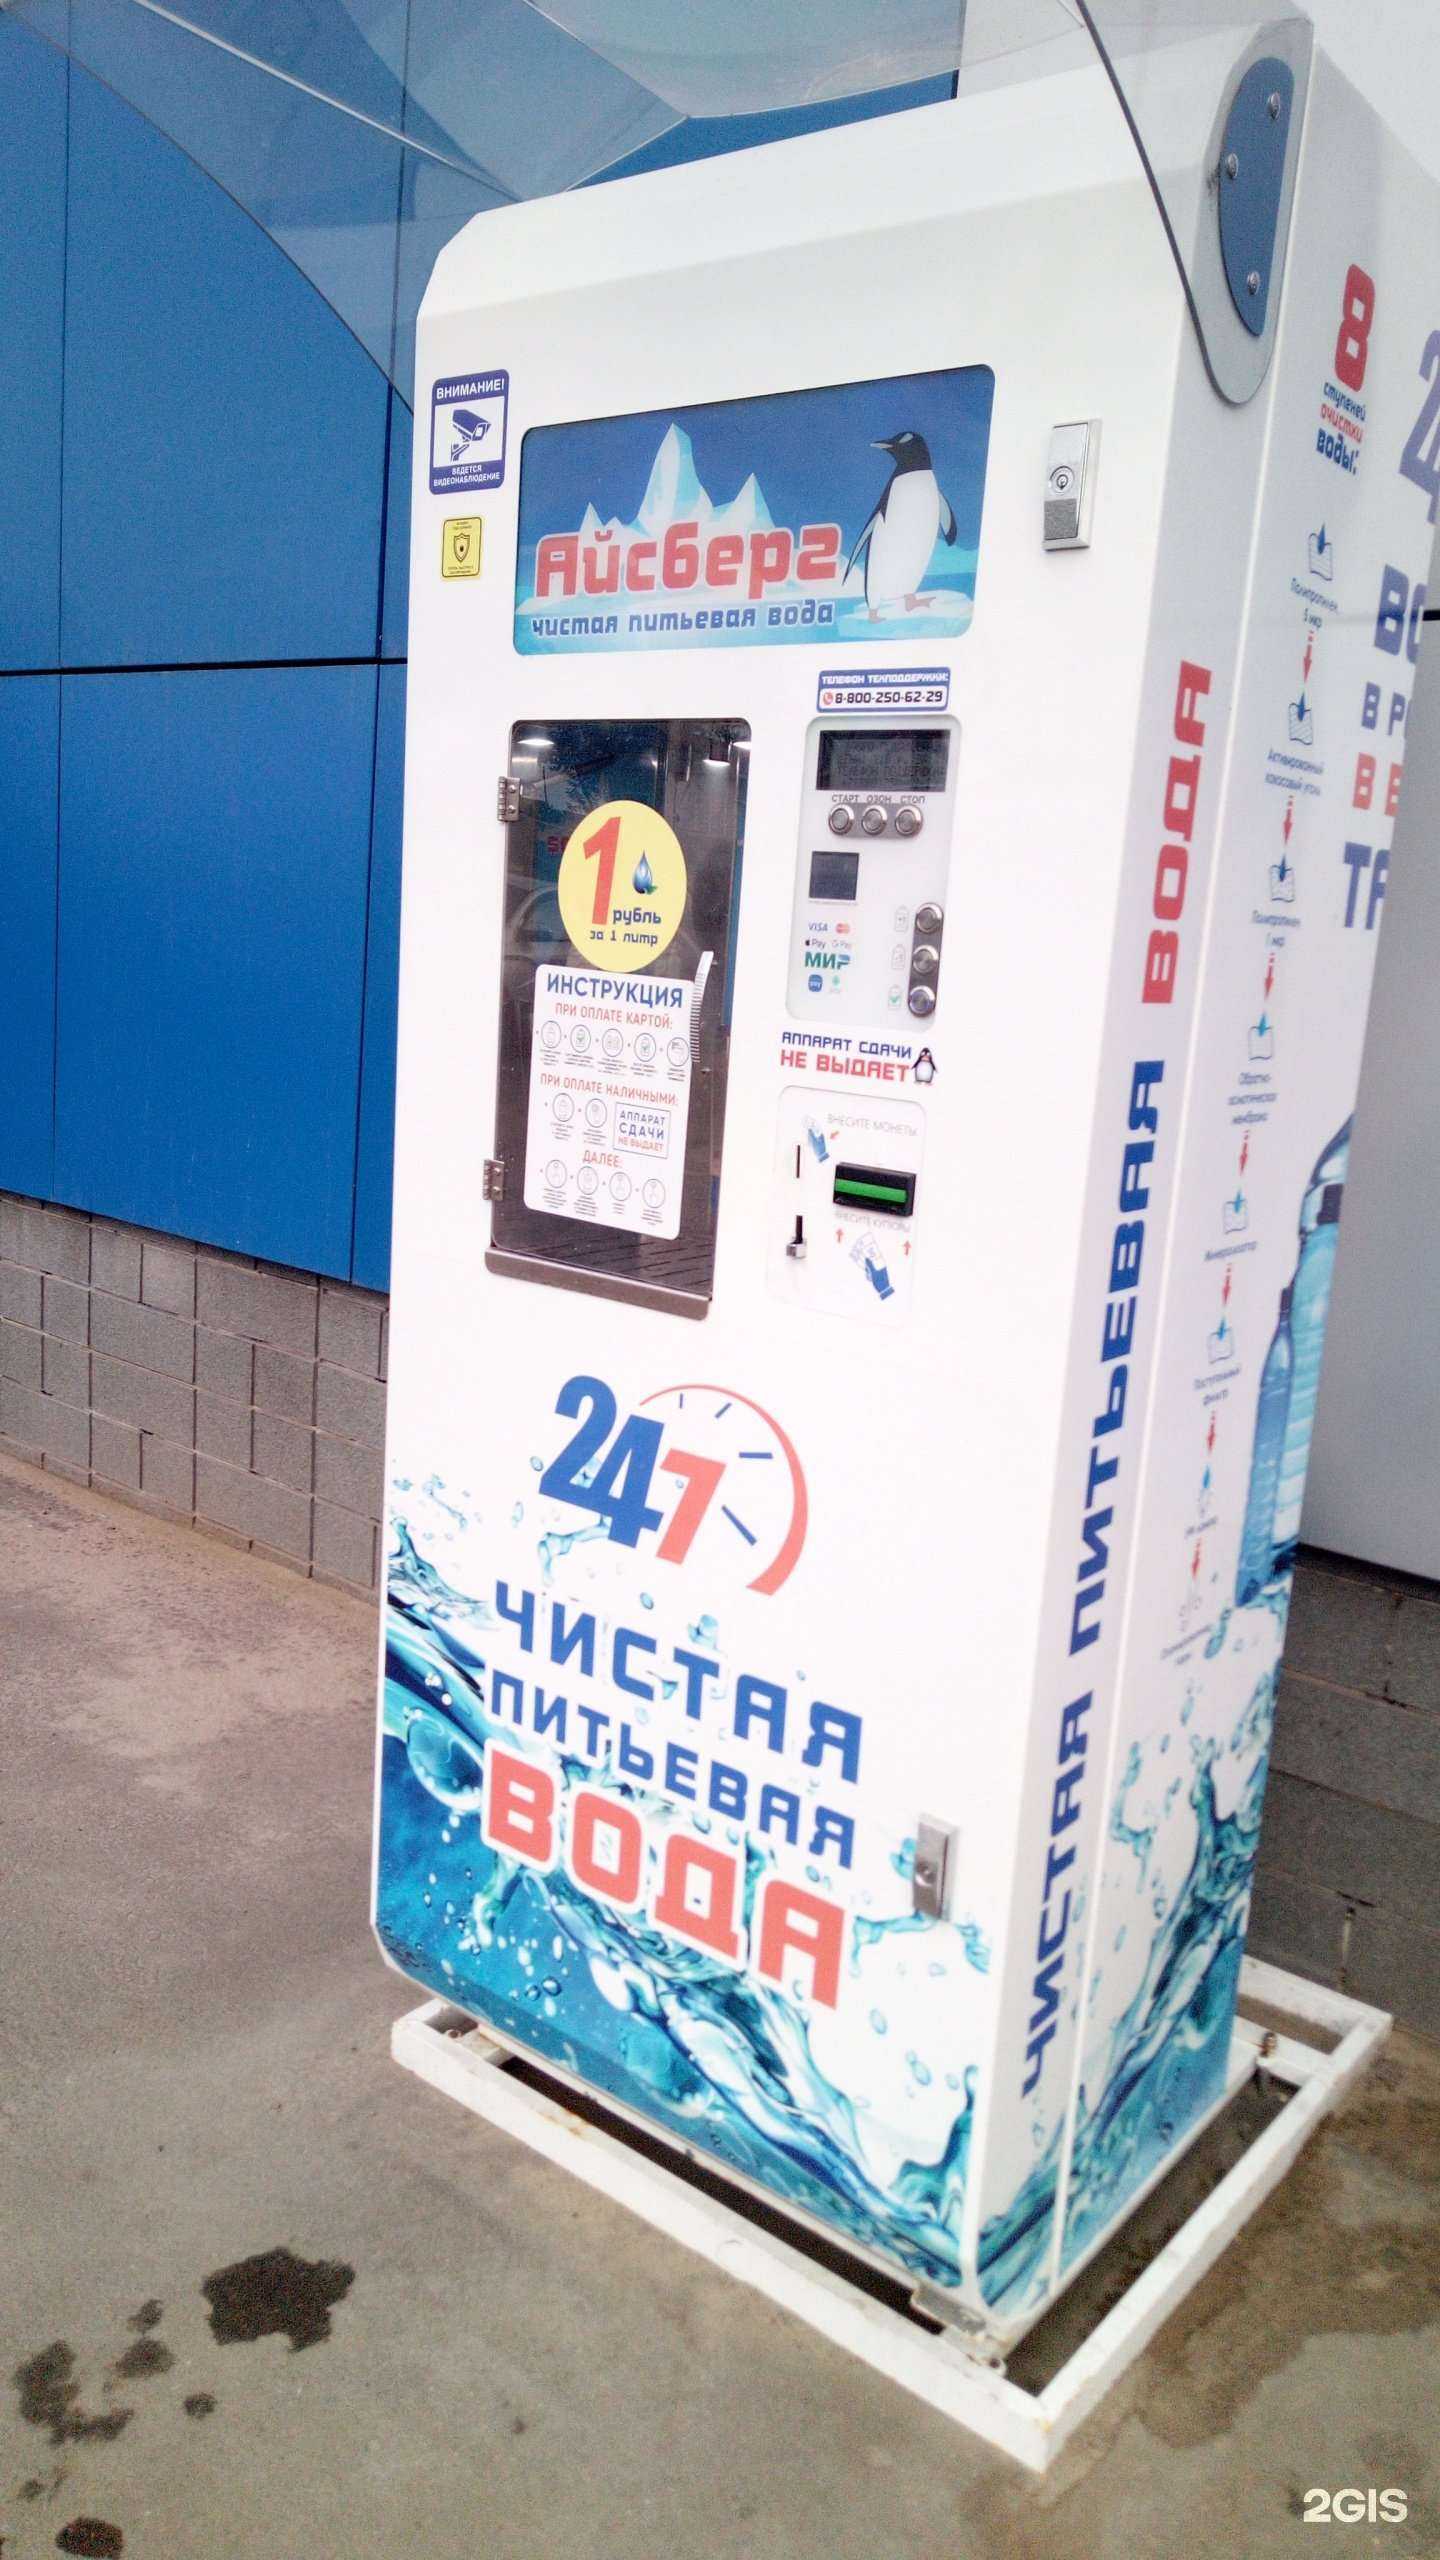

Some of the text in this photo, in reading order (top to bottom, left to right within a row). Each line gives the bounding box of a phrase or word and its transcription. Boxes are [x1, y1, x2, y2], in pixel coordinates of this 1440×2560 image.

[1334, 263, 1375, 392] 8
[436, 378, 505, 400] ВНИМАНИЕ!
[1320, 403, 1364, 443] очистки
[433, 472, 500, 488] ВИДЕОНАБЛЮДЕНИЕ
[451, 465, 482, 476] ВЕДЕТСЯ
[535, 522, 840, 599] Айсберг
[532, 600, 833, 637] чистая питьевая вода
[822, 675, 865, 685] ТЕЛЕФОН
[835, 691, 943, 704] 8-800-250-62-29
[1361, 681, 1381, 730] В
[1352, 752, 1377, 810] В
[831, 794, 859, 804] СТАРТ
[866, 794, 892, 804] ОЗОН
[900, 795, 926, 804] СТОП
[583, 816, 621, 926] 1
[613, 907, 662, 925] рубль
[808, 922, 828, 932] VISA
[589, 930, 658, 947] за 1 литр
[805, 951, 850, 970] МИР
[547, 973, 683, 1008] ИНСТРУКЦИЯ
[555, 1002, 672, 1030] ПРИ ОПЛАТЕ КАРТОЙ:
[782, 1031, 912, 1059] АППАРАТ СДАЧИ
[780, 1049, 910, 1083] НЕ ВЫДАЕТ
[540, 1072, 679, 1106] ПРИ ОПЛАТЕ НАЛИЧНЫМИ:
[618, 1123, 664, 1140] СДАЧИ
[619, 1110, 666, 1126] АППАРАТ
[617, 1136, 629, 1146] НЕ
[630, 1138, 664, 1152] ВЫДАЕТ
[1021, 659, 1212, 2099] ЧИСТАЯ ПИТЬЕВАЯ ВОДА
[494, 1579, 862, 1784] ЧИСТАЯ
[491, 1668, 855, 1870] ПИТЬЕВАЯ
[487, 1748, 846, 2011] ВОДА
